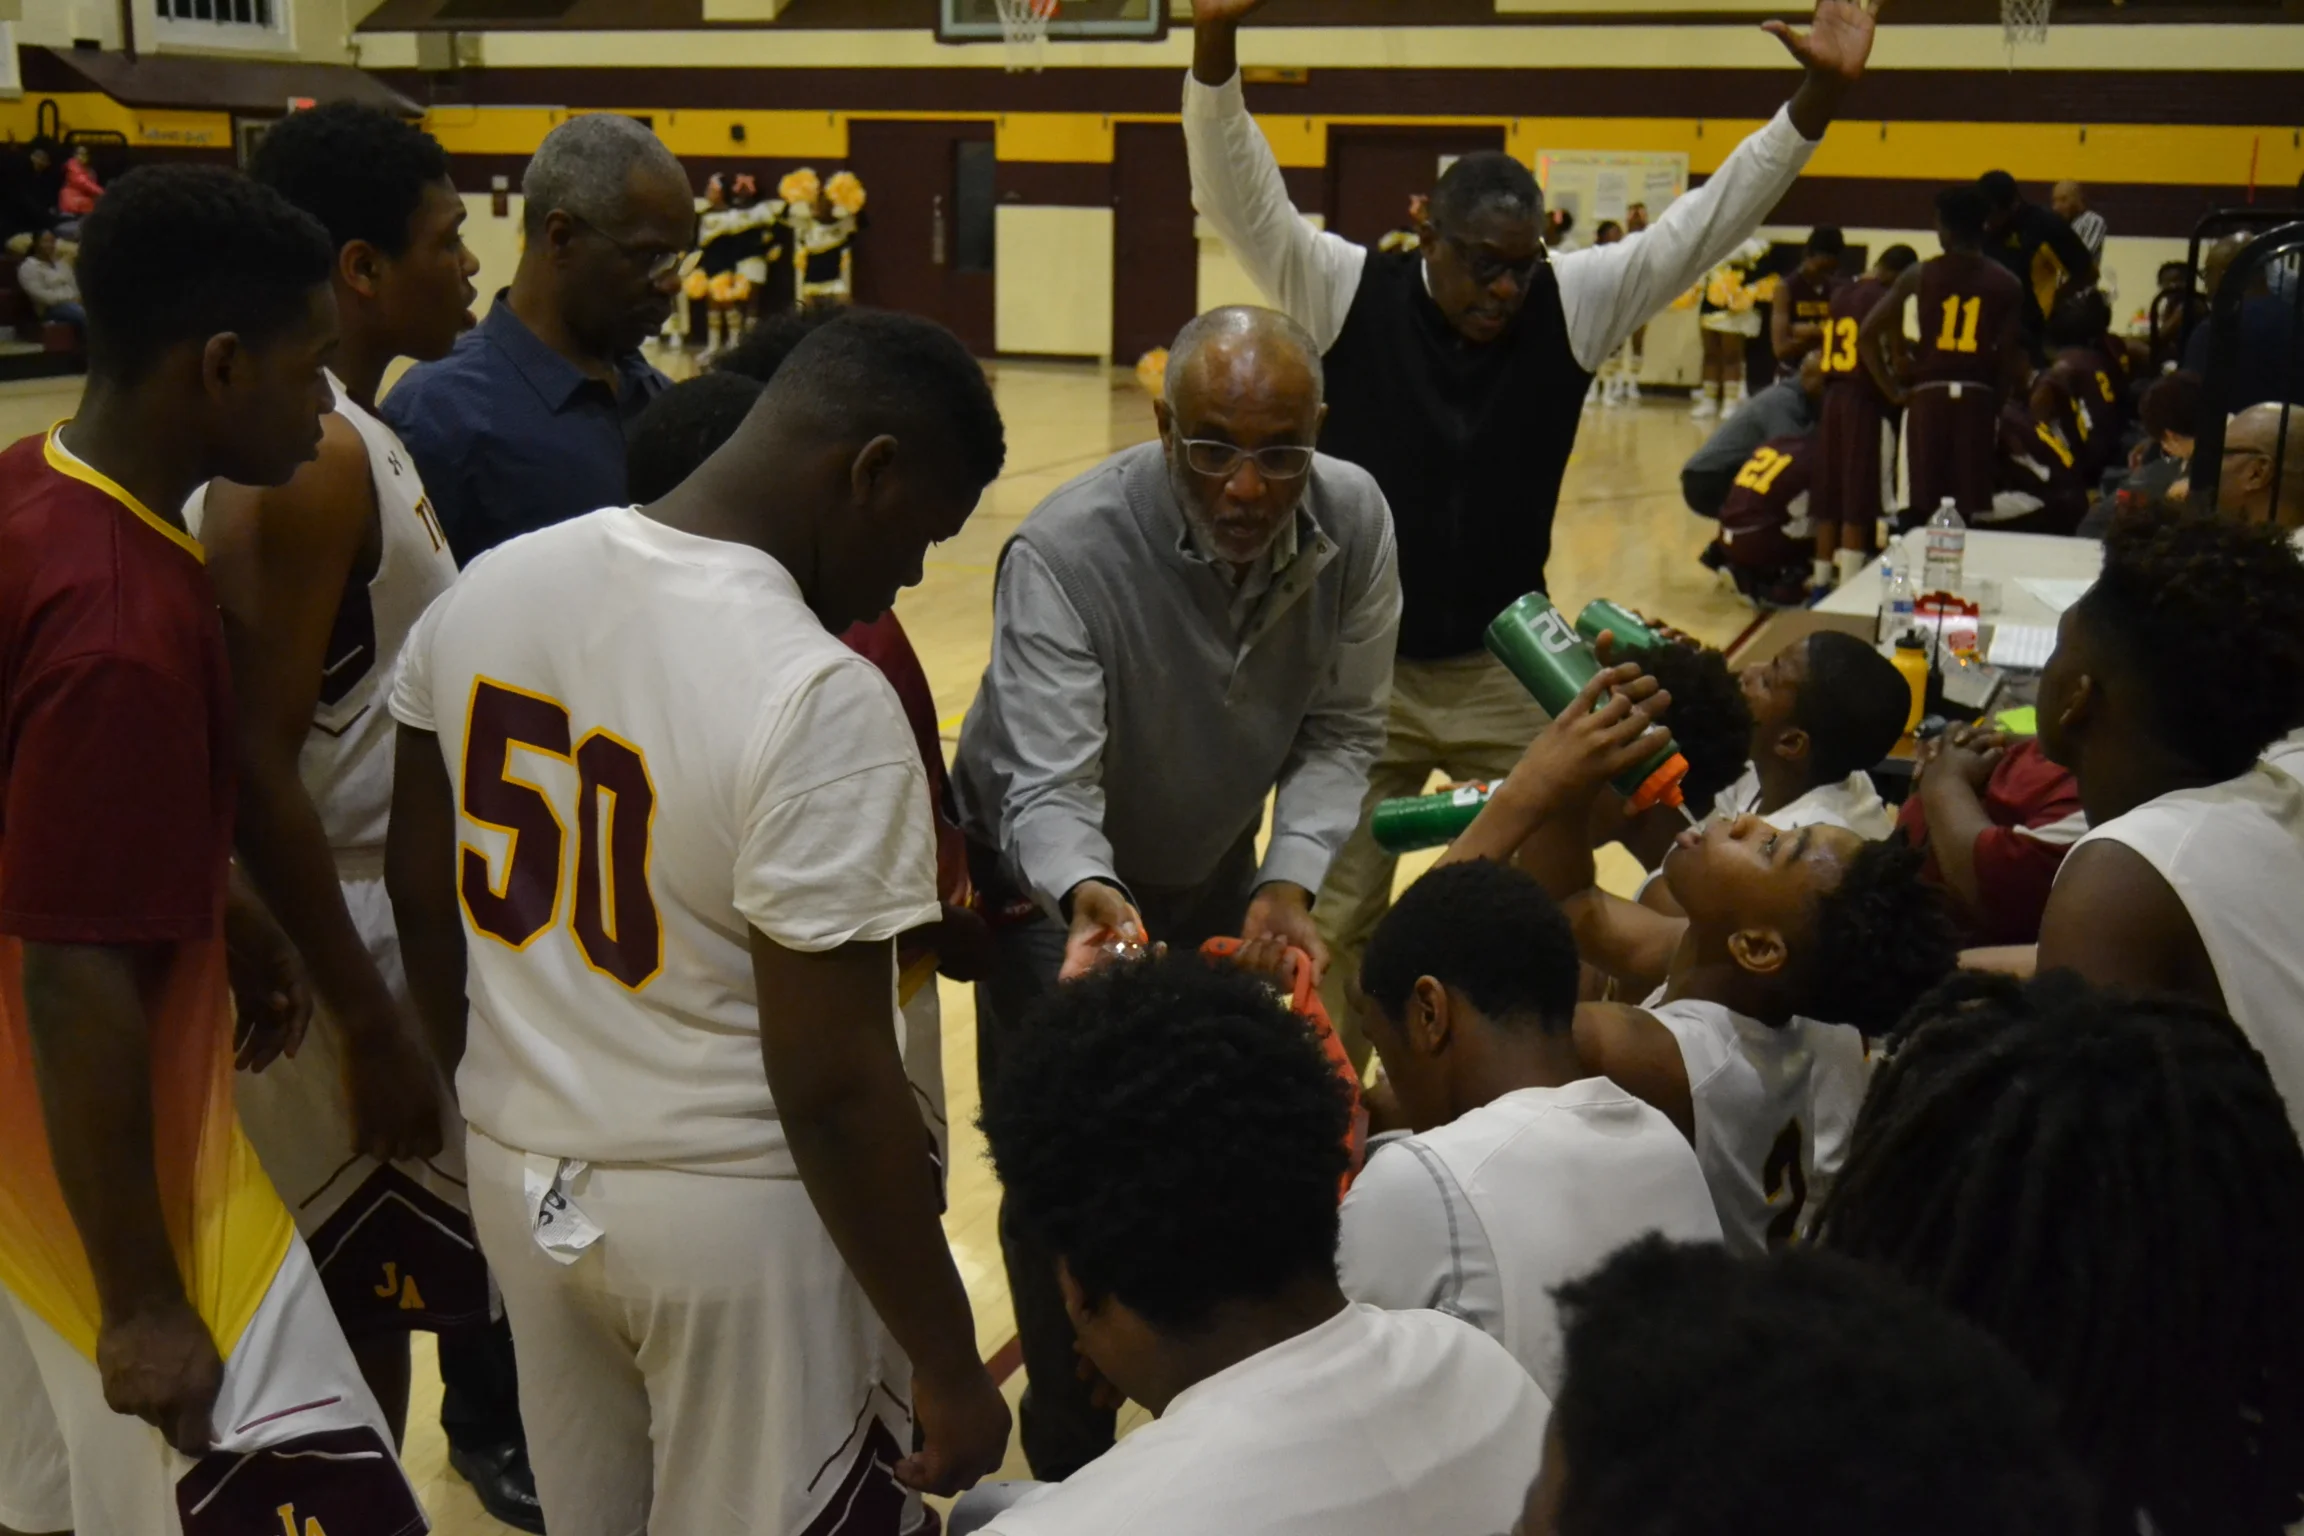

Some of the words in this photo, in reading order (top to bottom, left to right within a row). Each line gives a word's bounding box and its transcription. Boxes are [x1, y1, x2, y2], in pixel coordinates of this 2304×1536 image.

[1820, 316, 1858, 373] 13
[1936, 294, 1983, 354] 11
[1734, 446, 1794, 496] 21
[457, 674, 664, 993] 50
[373, 1261, 426, 1310] JA
